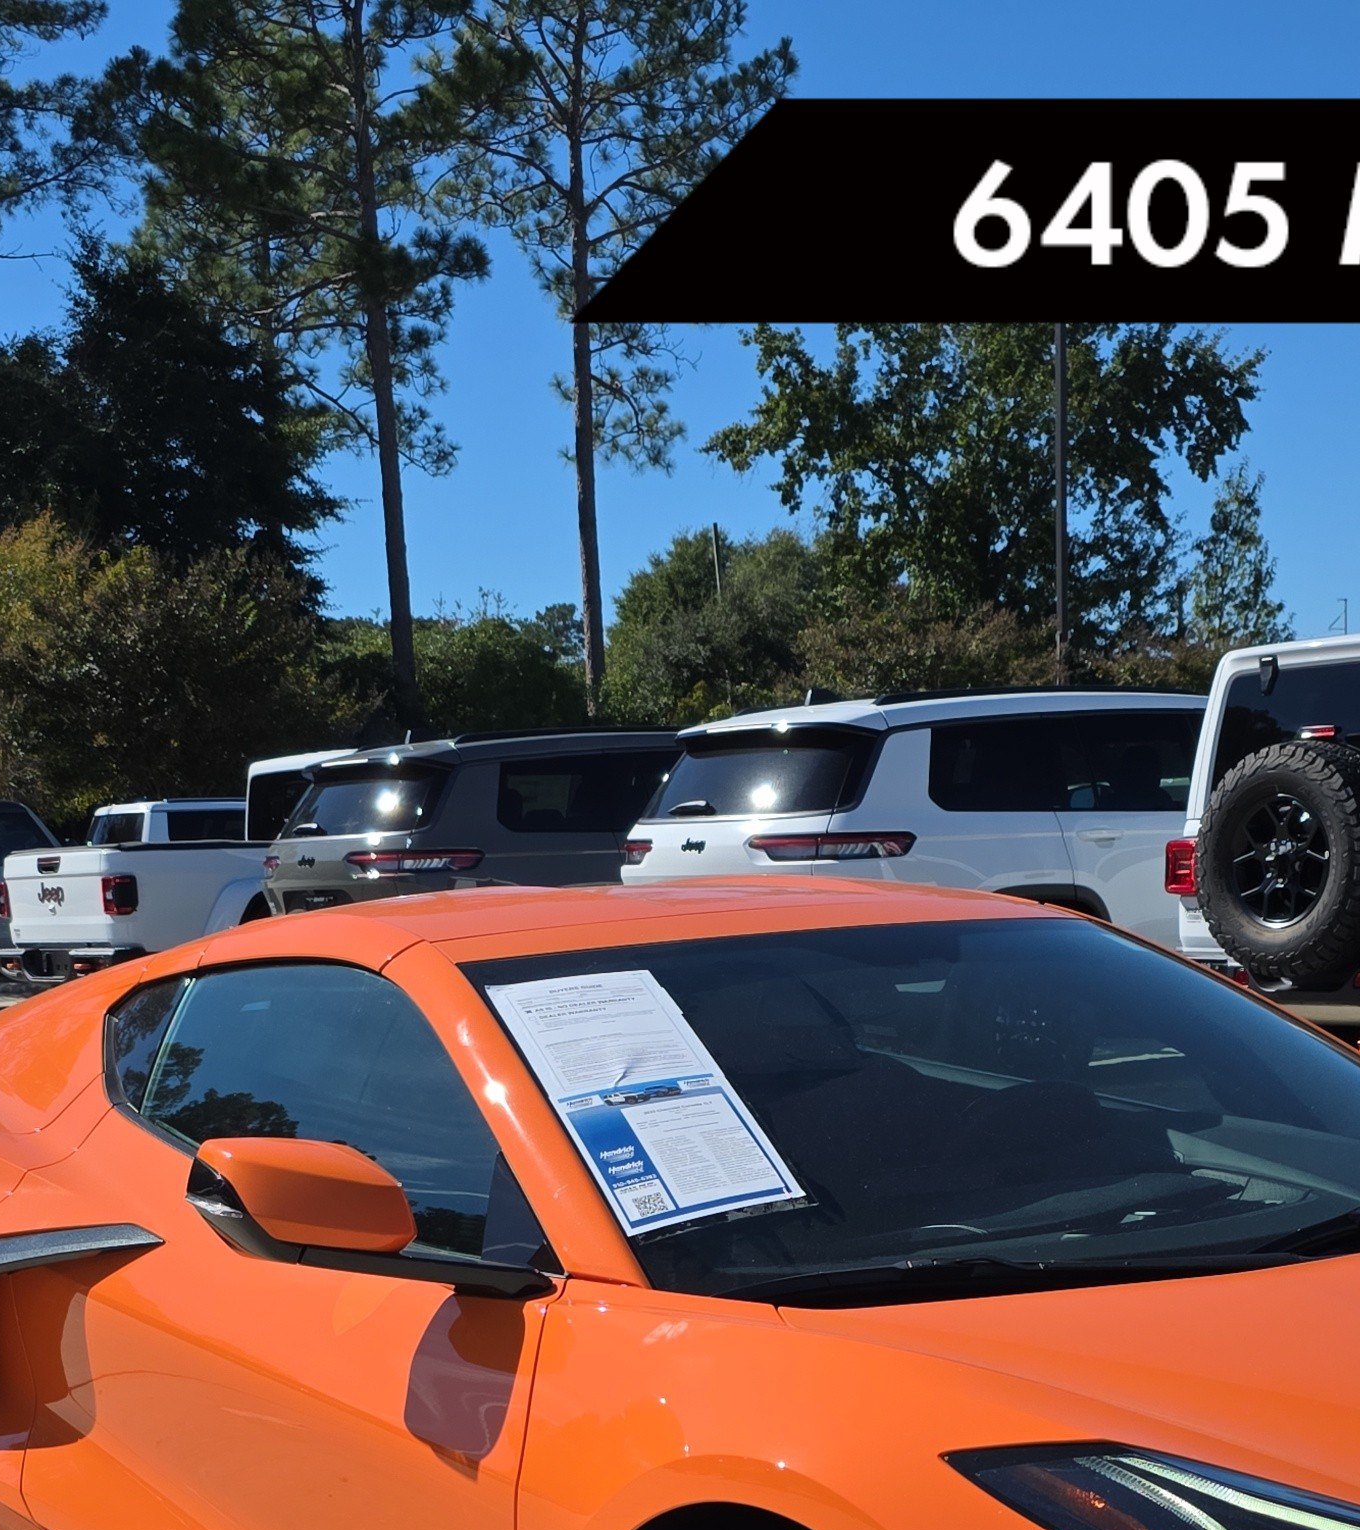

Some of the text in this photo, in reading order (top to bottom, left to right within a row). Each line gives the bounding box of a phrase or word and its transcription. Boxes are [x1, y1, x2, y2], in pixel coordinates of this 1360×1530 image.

[38, 882, 65, 907] Jeep
[599, 1145, 635, 1160] Hendrick
[608, 1160, 644, 1175] Hendrick
